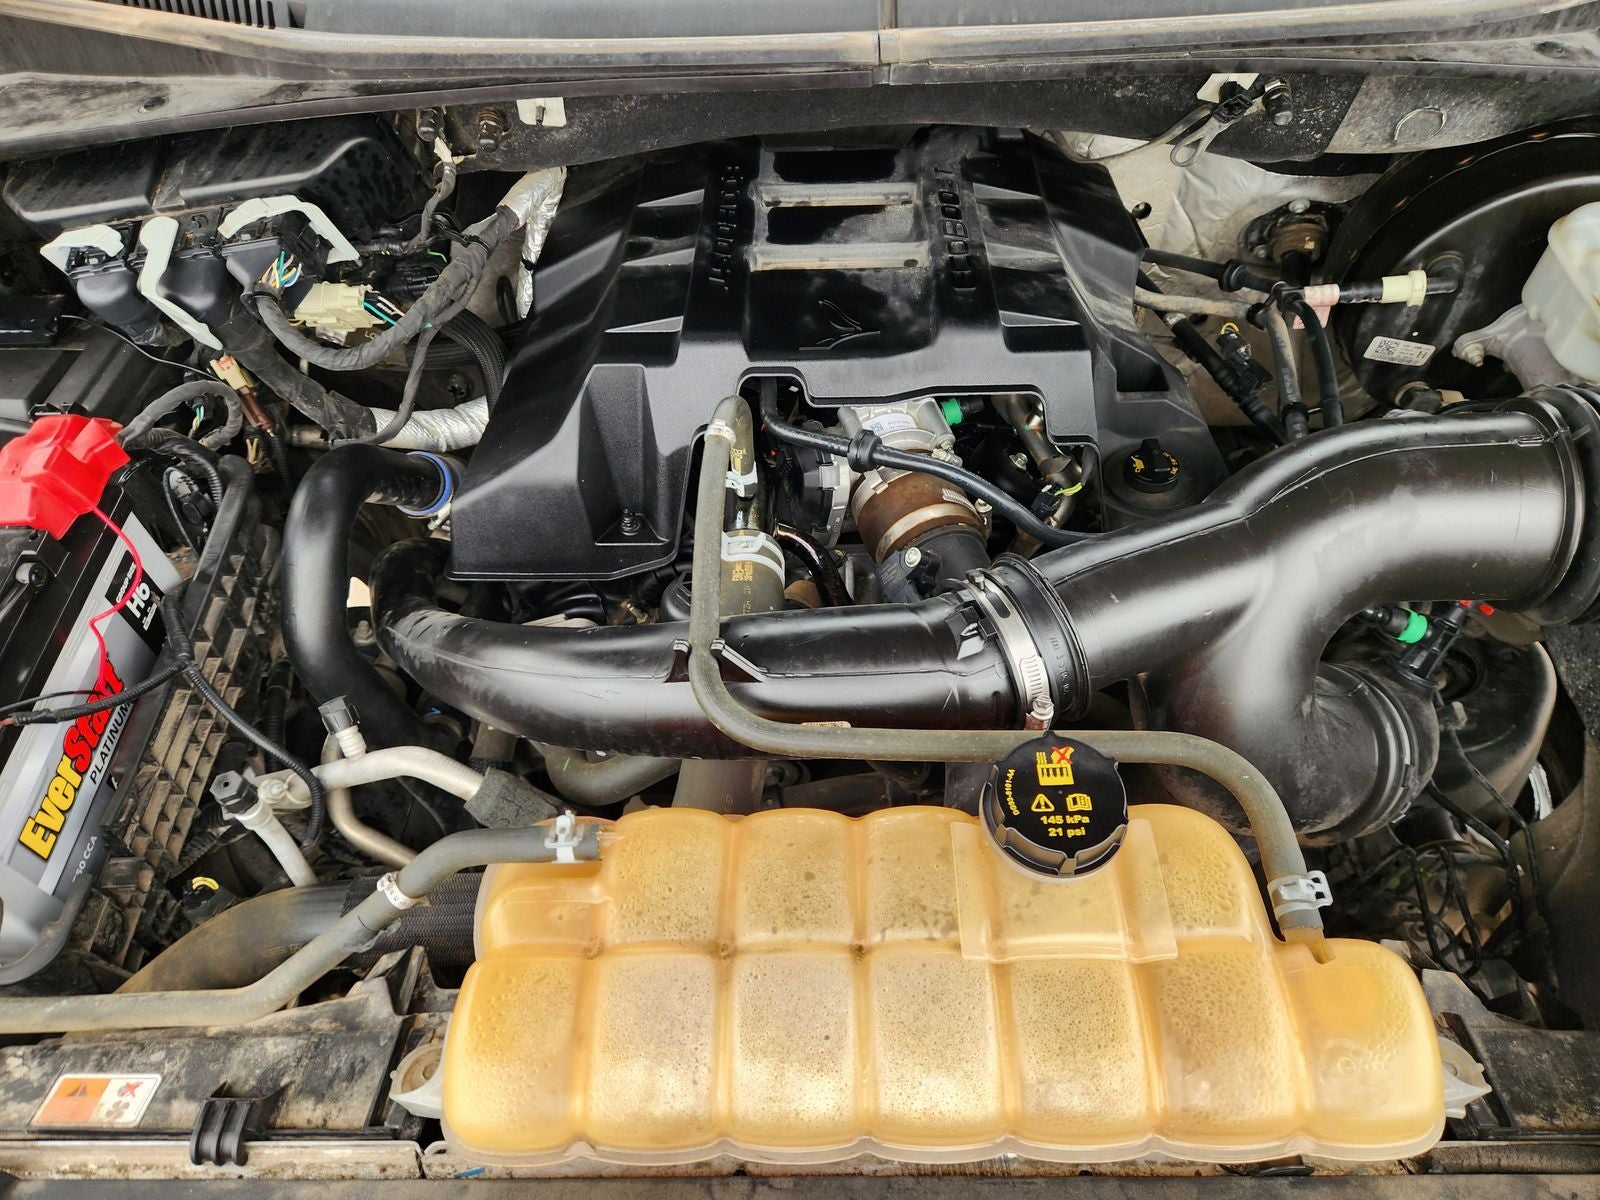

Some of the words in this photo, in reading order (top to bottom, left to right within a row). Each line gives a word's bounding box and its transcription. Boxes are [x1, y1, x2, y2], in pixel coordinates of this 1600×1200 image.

[933, 166, 977, 292] ECOBOOST
[125, 582, 151, 619] H6
[90, 700, 133, 785] PLATINUM
[1040, 815, 1064, 825] 145
[1065, 814, 1091, 824] kPa
[1048, 827, 1063, 837] 21
[1066, 826, 1086, 838] psi
[72, 860, 86, 883] 50
[83, 836, 98, 860] CCA
